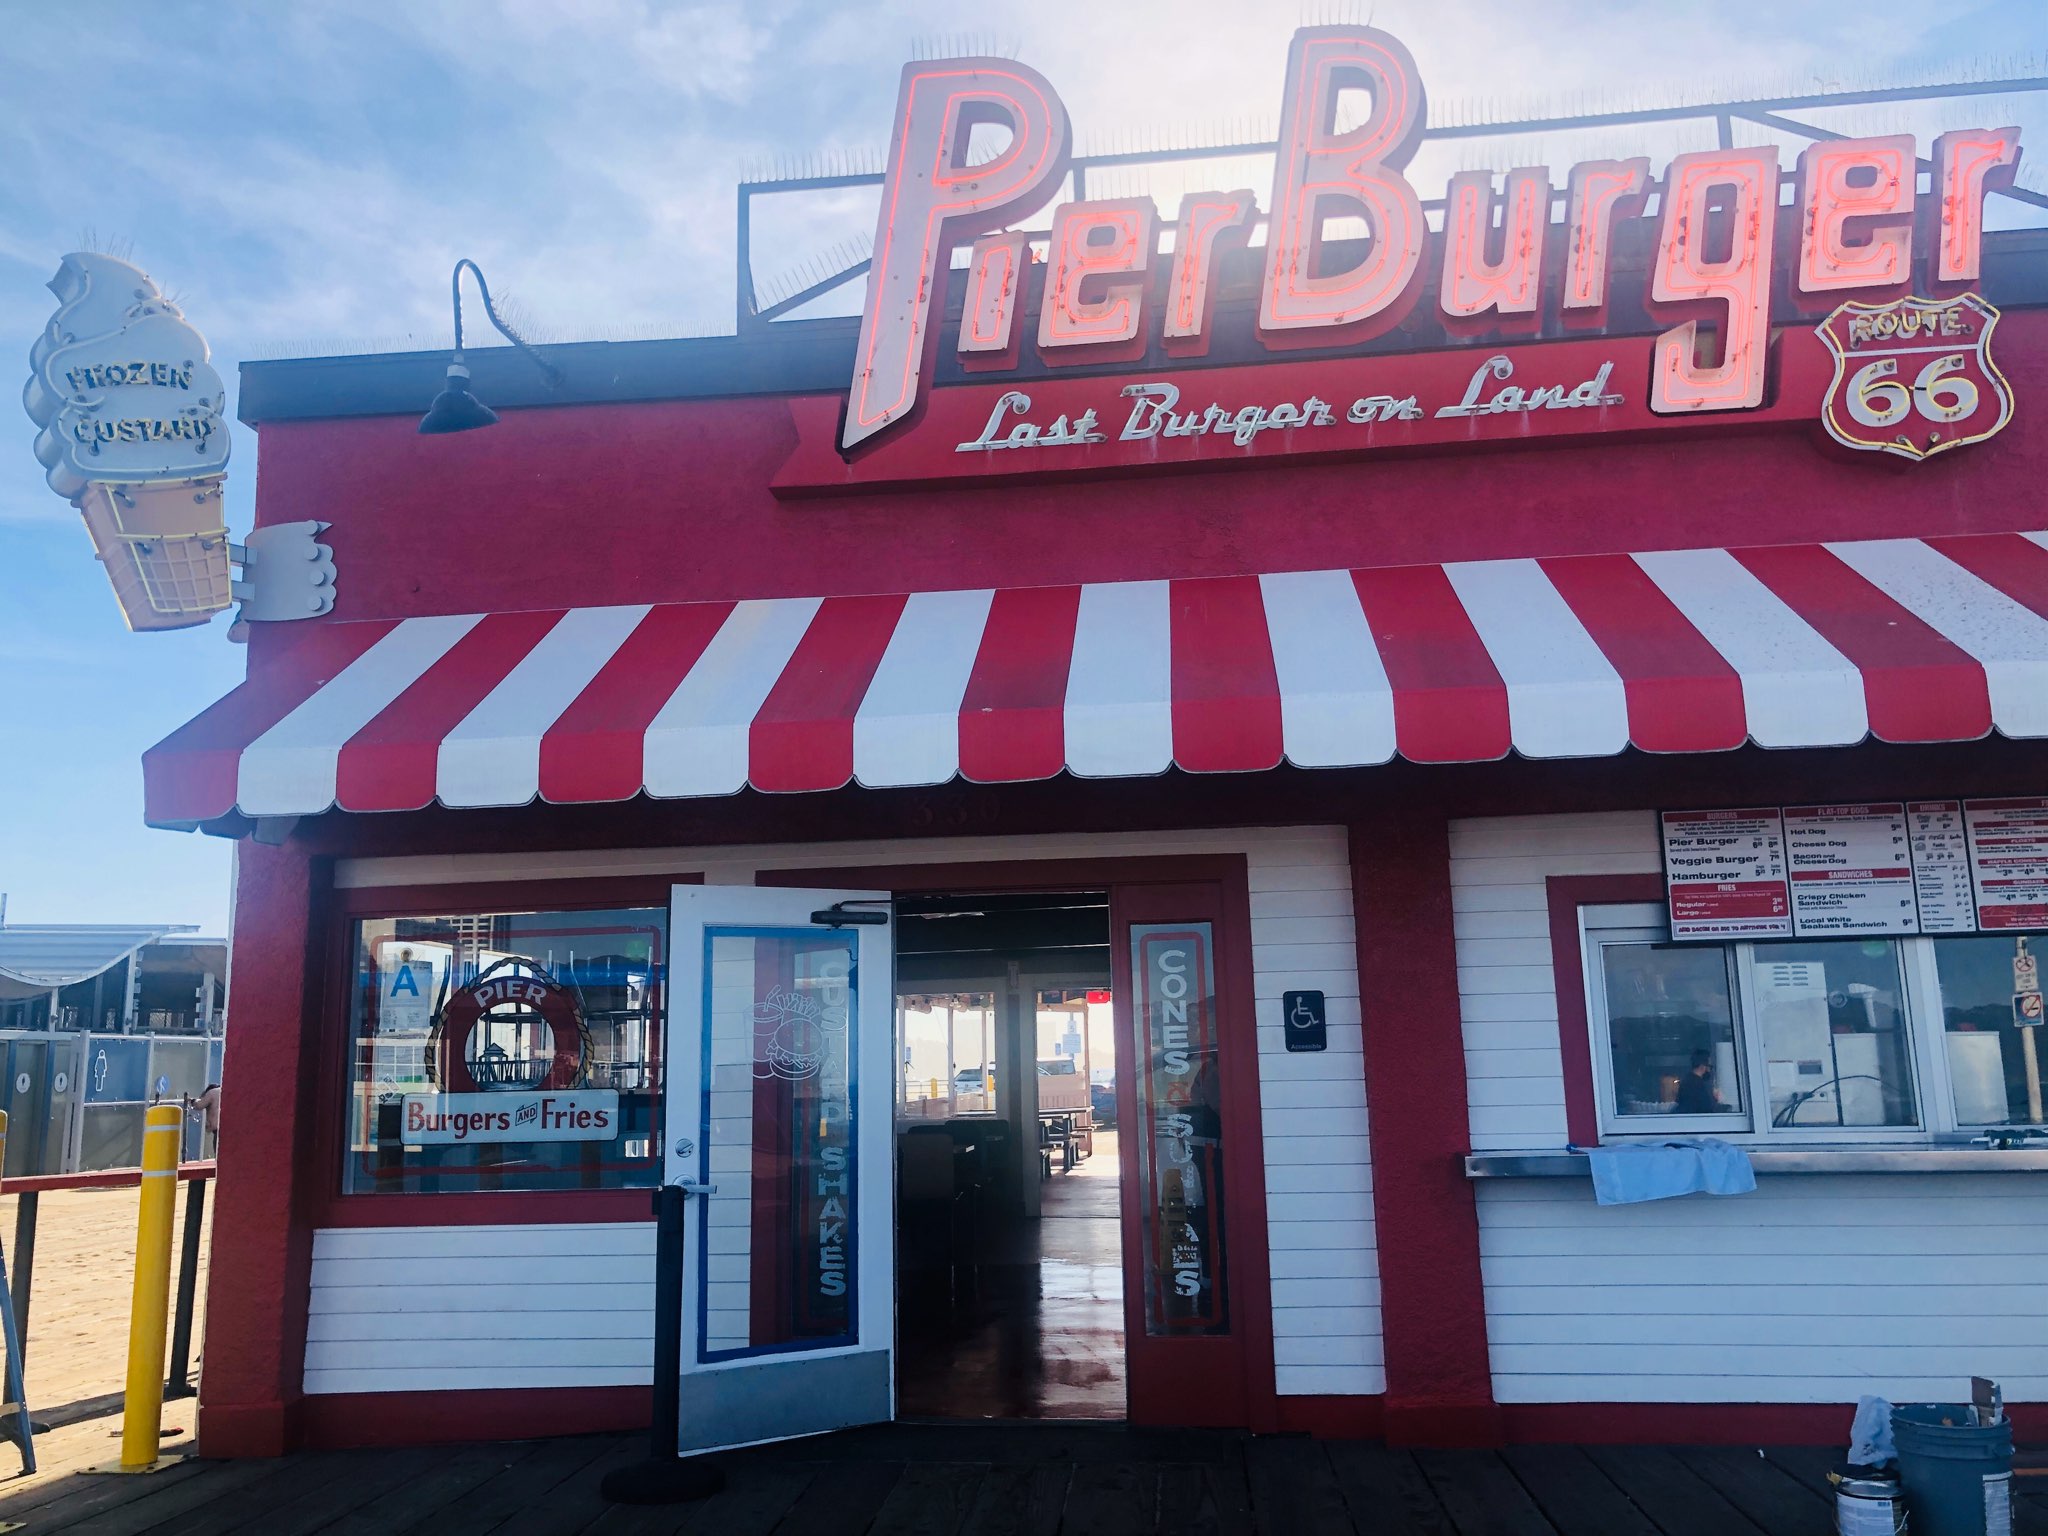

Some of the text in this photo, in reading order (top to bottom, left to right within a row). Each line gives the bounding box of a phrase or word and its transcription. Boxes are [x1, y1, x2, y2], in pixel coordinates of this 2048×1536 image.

[1849, 307, 1968, 343] ROUTE
[66, 360, 193, 391] FROZEN
[955, 355, 1625, 452] Last Burger on Land
[1846, 356, 1979, 428] 66
[74, 418, 215, 443] CUSTARD
[1669, 837, 1739, 847] Pier Burger
[1828, 840, 1847, 848] Dog
[1670, 857, 1712, 867] Veggie
[1715, 855, 1759, 865] Burger
[1671, 871, 1741, 881] Hamburger
[1828, 870, 1873, 879] SANDWICHES
[1717, 884, 1737, 892] FRIES
[1676, 901, 1706, 909] Regular
[1798, 899, 1843, 907] Sandwich
[1800, 921, 1888, 930] Seabass Sandwich
[390, 965, 419, 997] A
[473, 980, 547, 1008] PIER
[1158, 949, 1190, 1076] CONES
[408, 1098, 609, 1139] Burgers AND Fries
[818, 1147, 848, 1297] SHAKES
